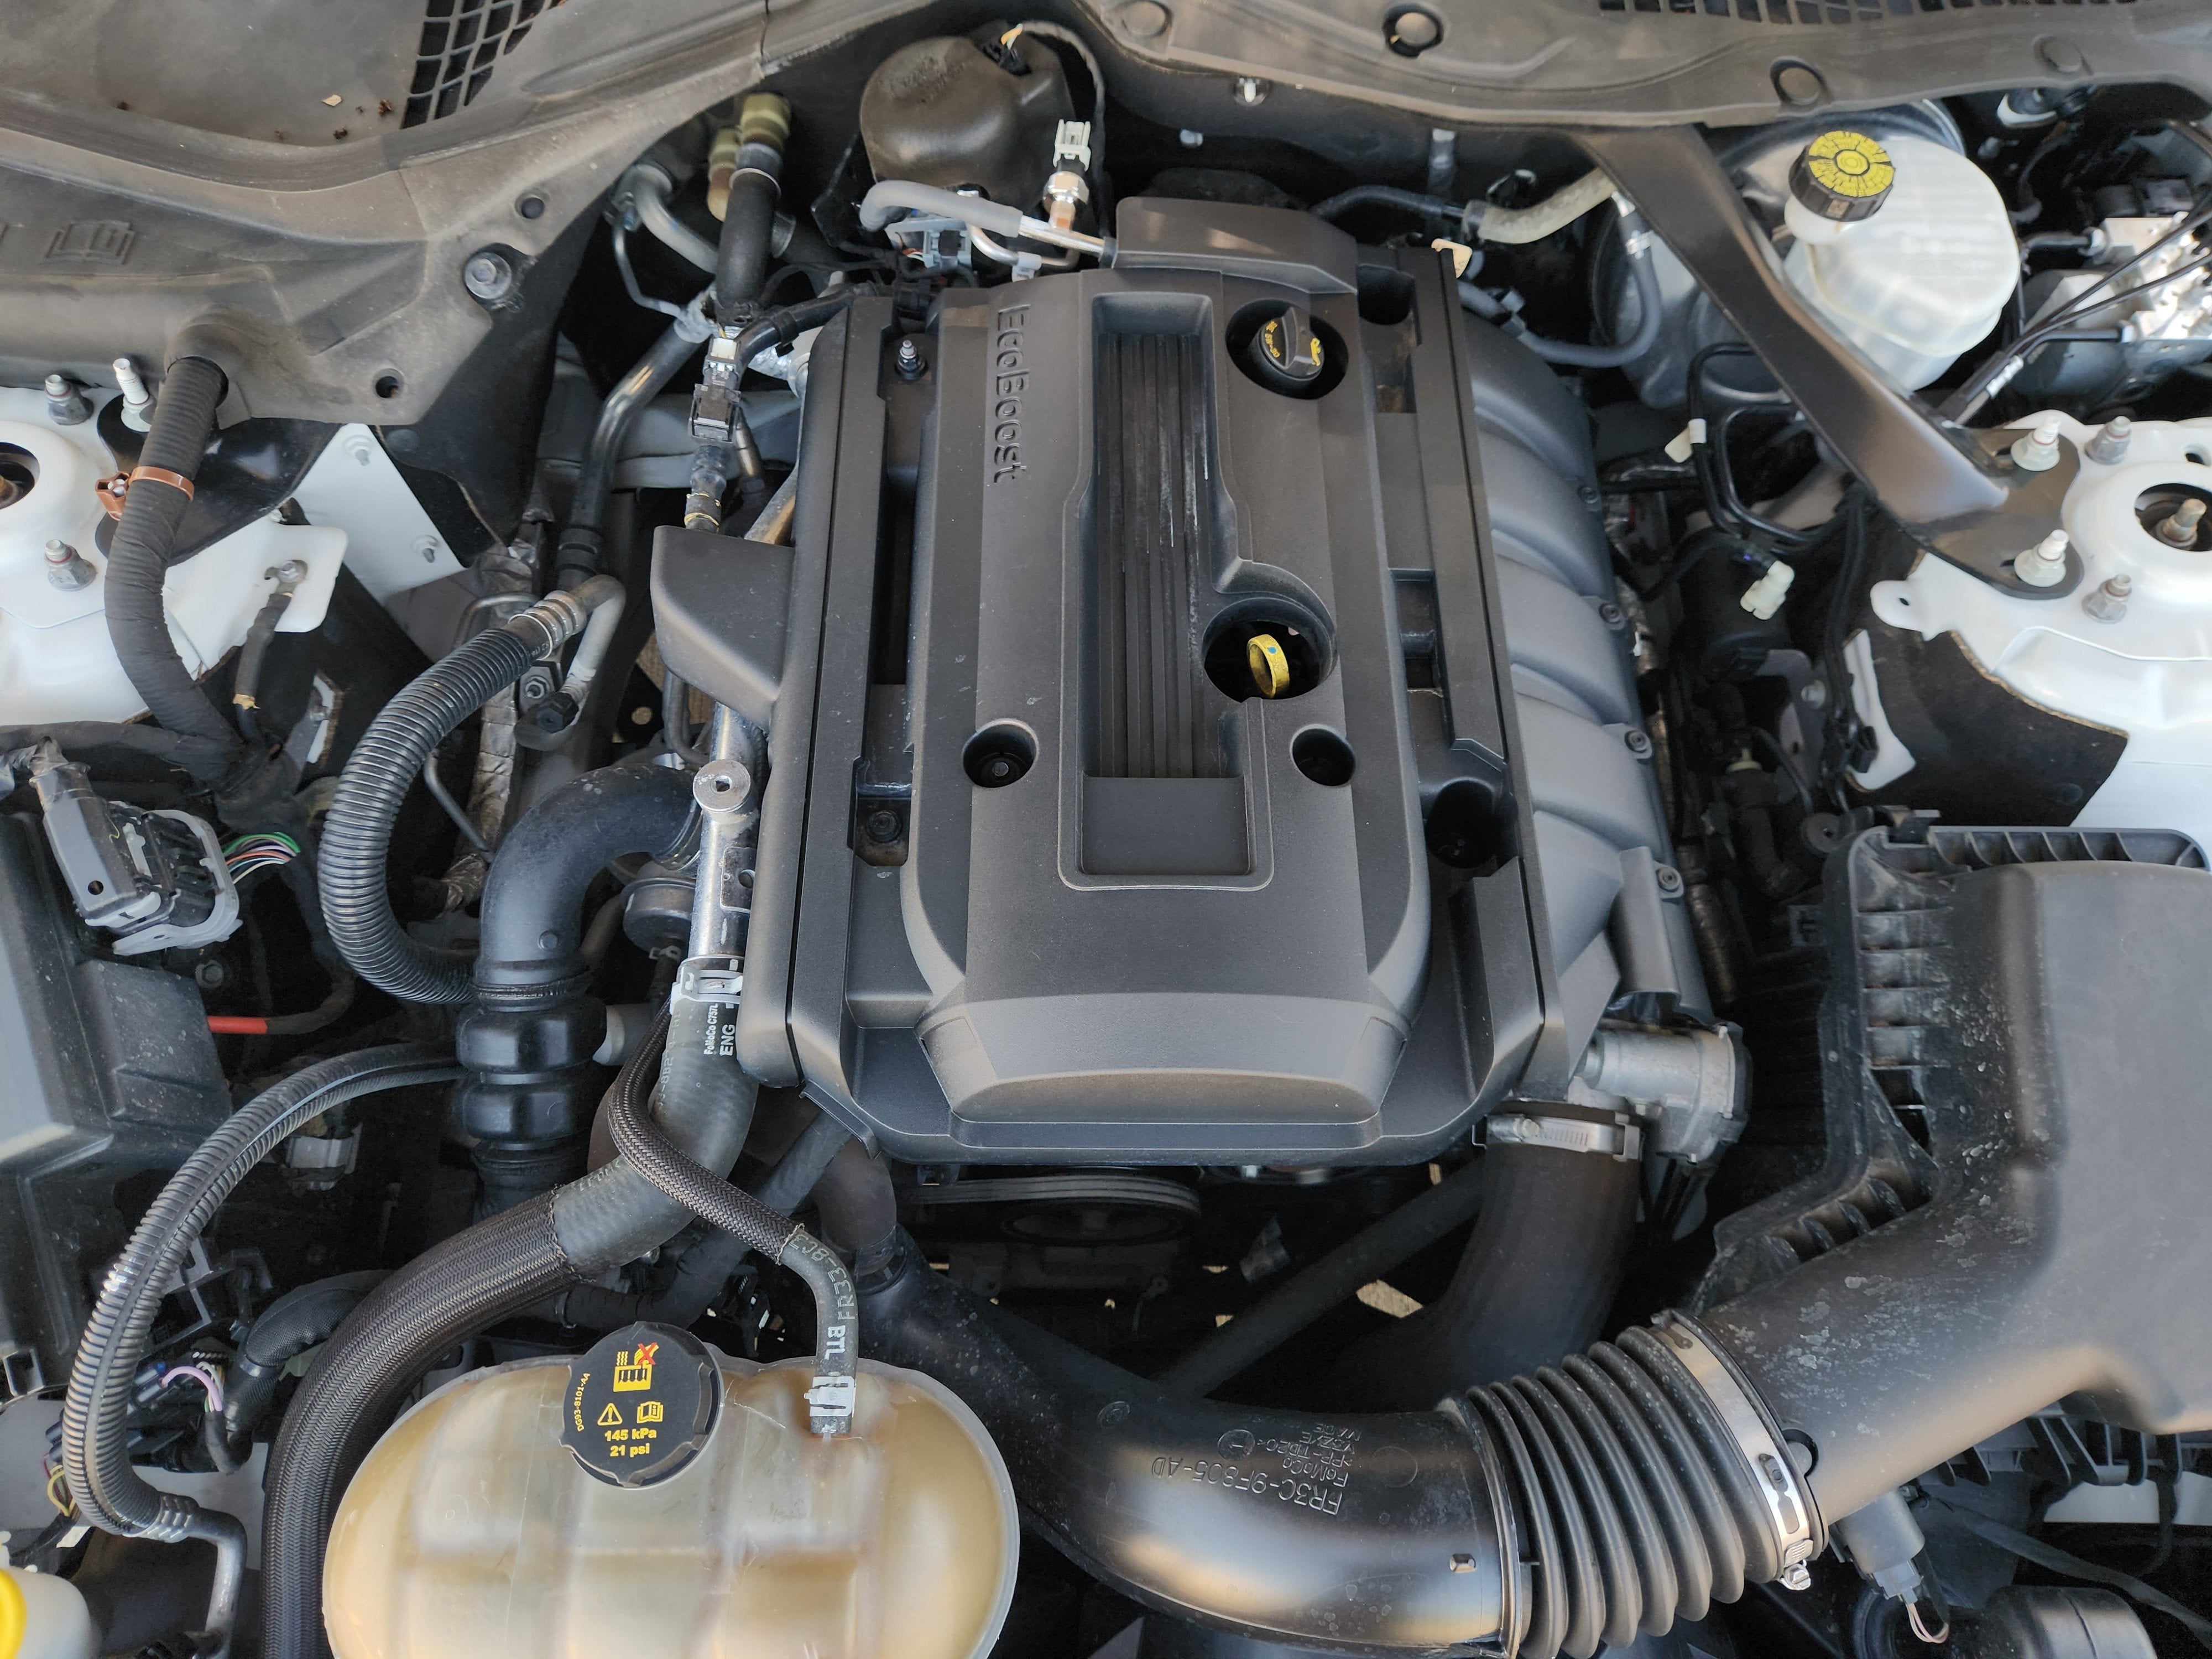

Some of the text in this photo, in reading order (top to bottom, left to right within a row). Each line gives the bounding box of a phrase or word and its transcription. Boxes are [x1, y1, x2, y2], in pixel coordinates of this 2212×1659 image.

[994, 304, 1030, 483] EcoBoost
[719, 1024, 735, 1056] ENG
[824, 1325, 846, 1360] BTL
[573, 1373, 591, 1432] DG93-8101-AA
[604, 1427, 657, 1442] 145 kPa
[610, 1442, 650, 1458] 21 psi
[1282, 1457, 1349, 1488] FoMoCo
